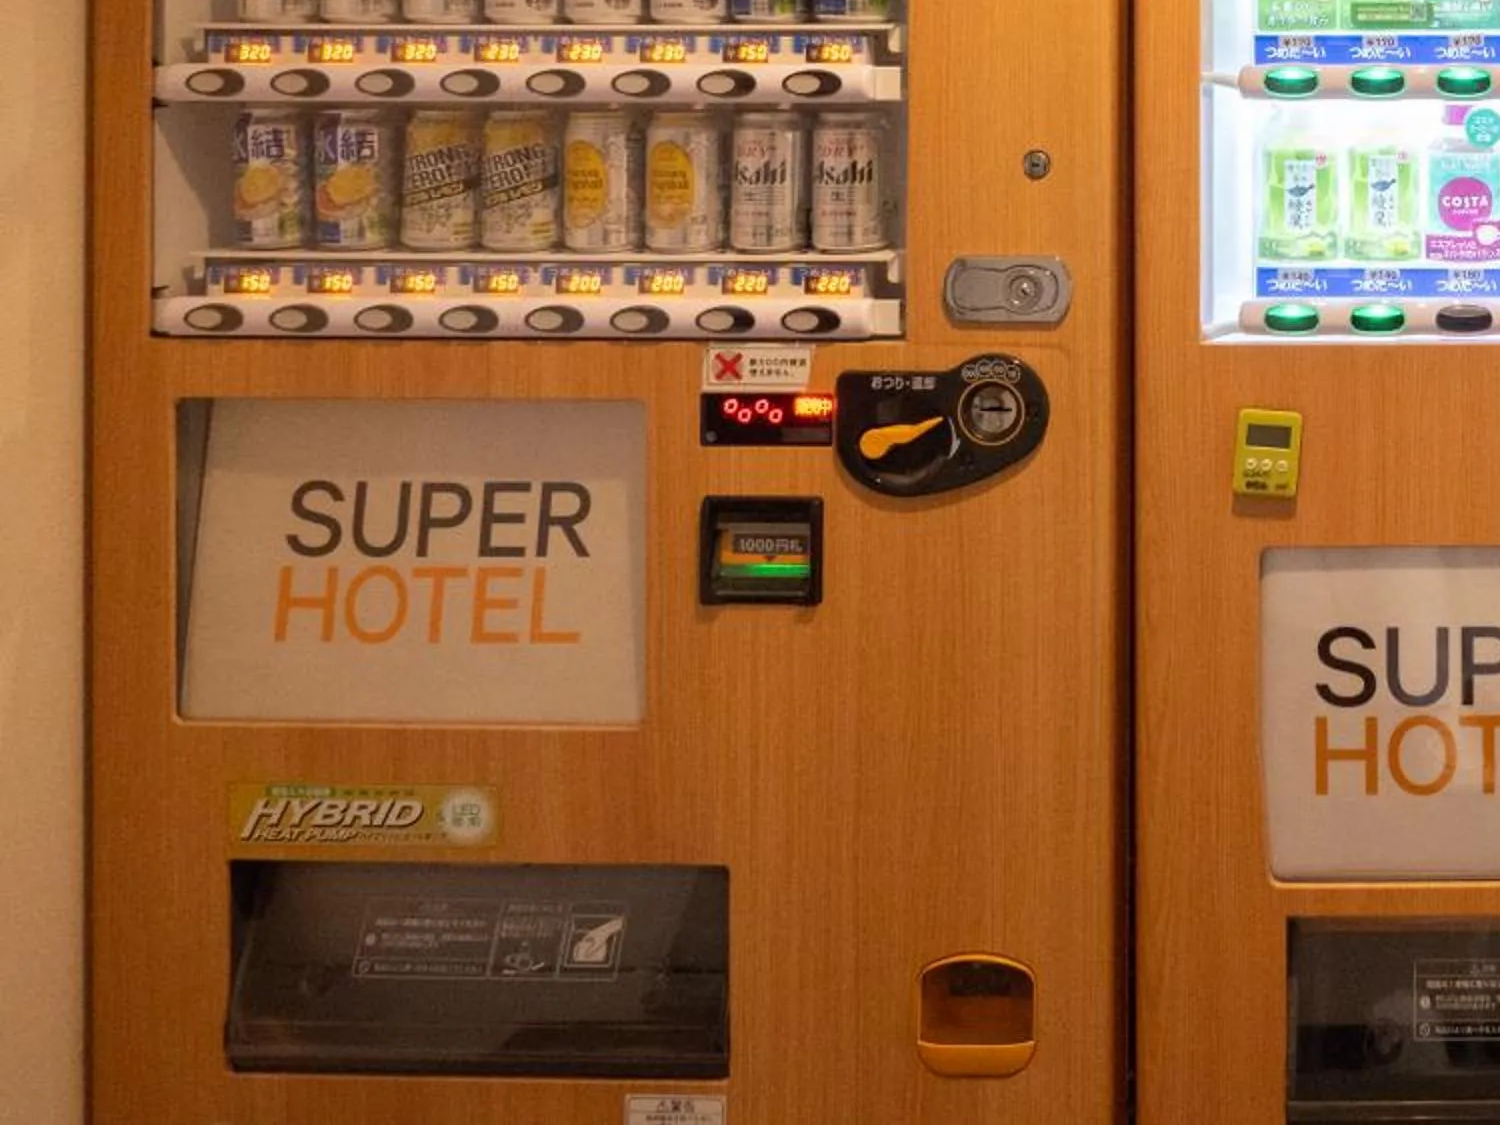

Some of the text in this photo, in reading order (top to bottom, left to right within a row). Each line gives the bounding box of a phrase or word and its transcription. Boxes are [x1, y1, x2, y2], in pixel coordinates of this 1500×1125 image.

[1442, 195, 1489, 208] COSTA
[285, 480, 591, 558] SUPER
[274, 566, 580, 644] HOTEL
[241, 796, 425, 842] HYBRID
